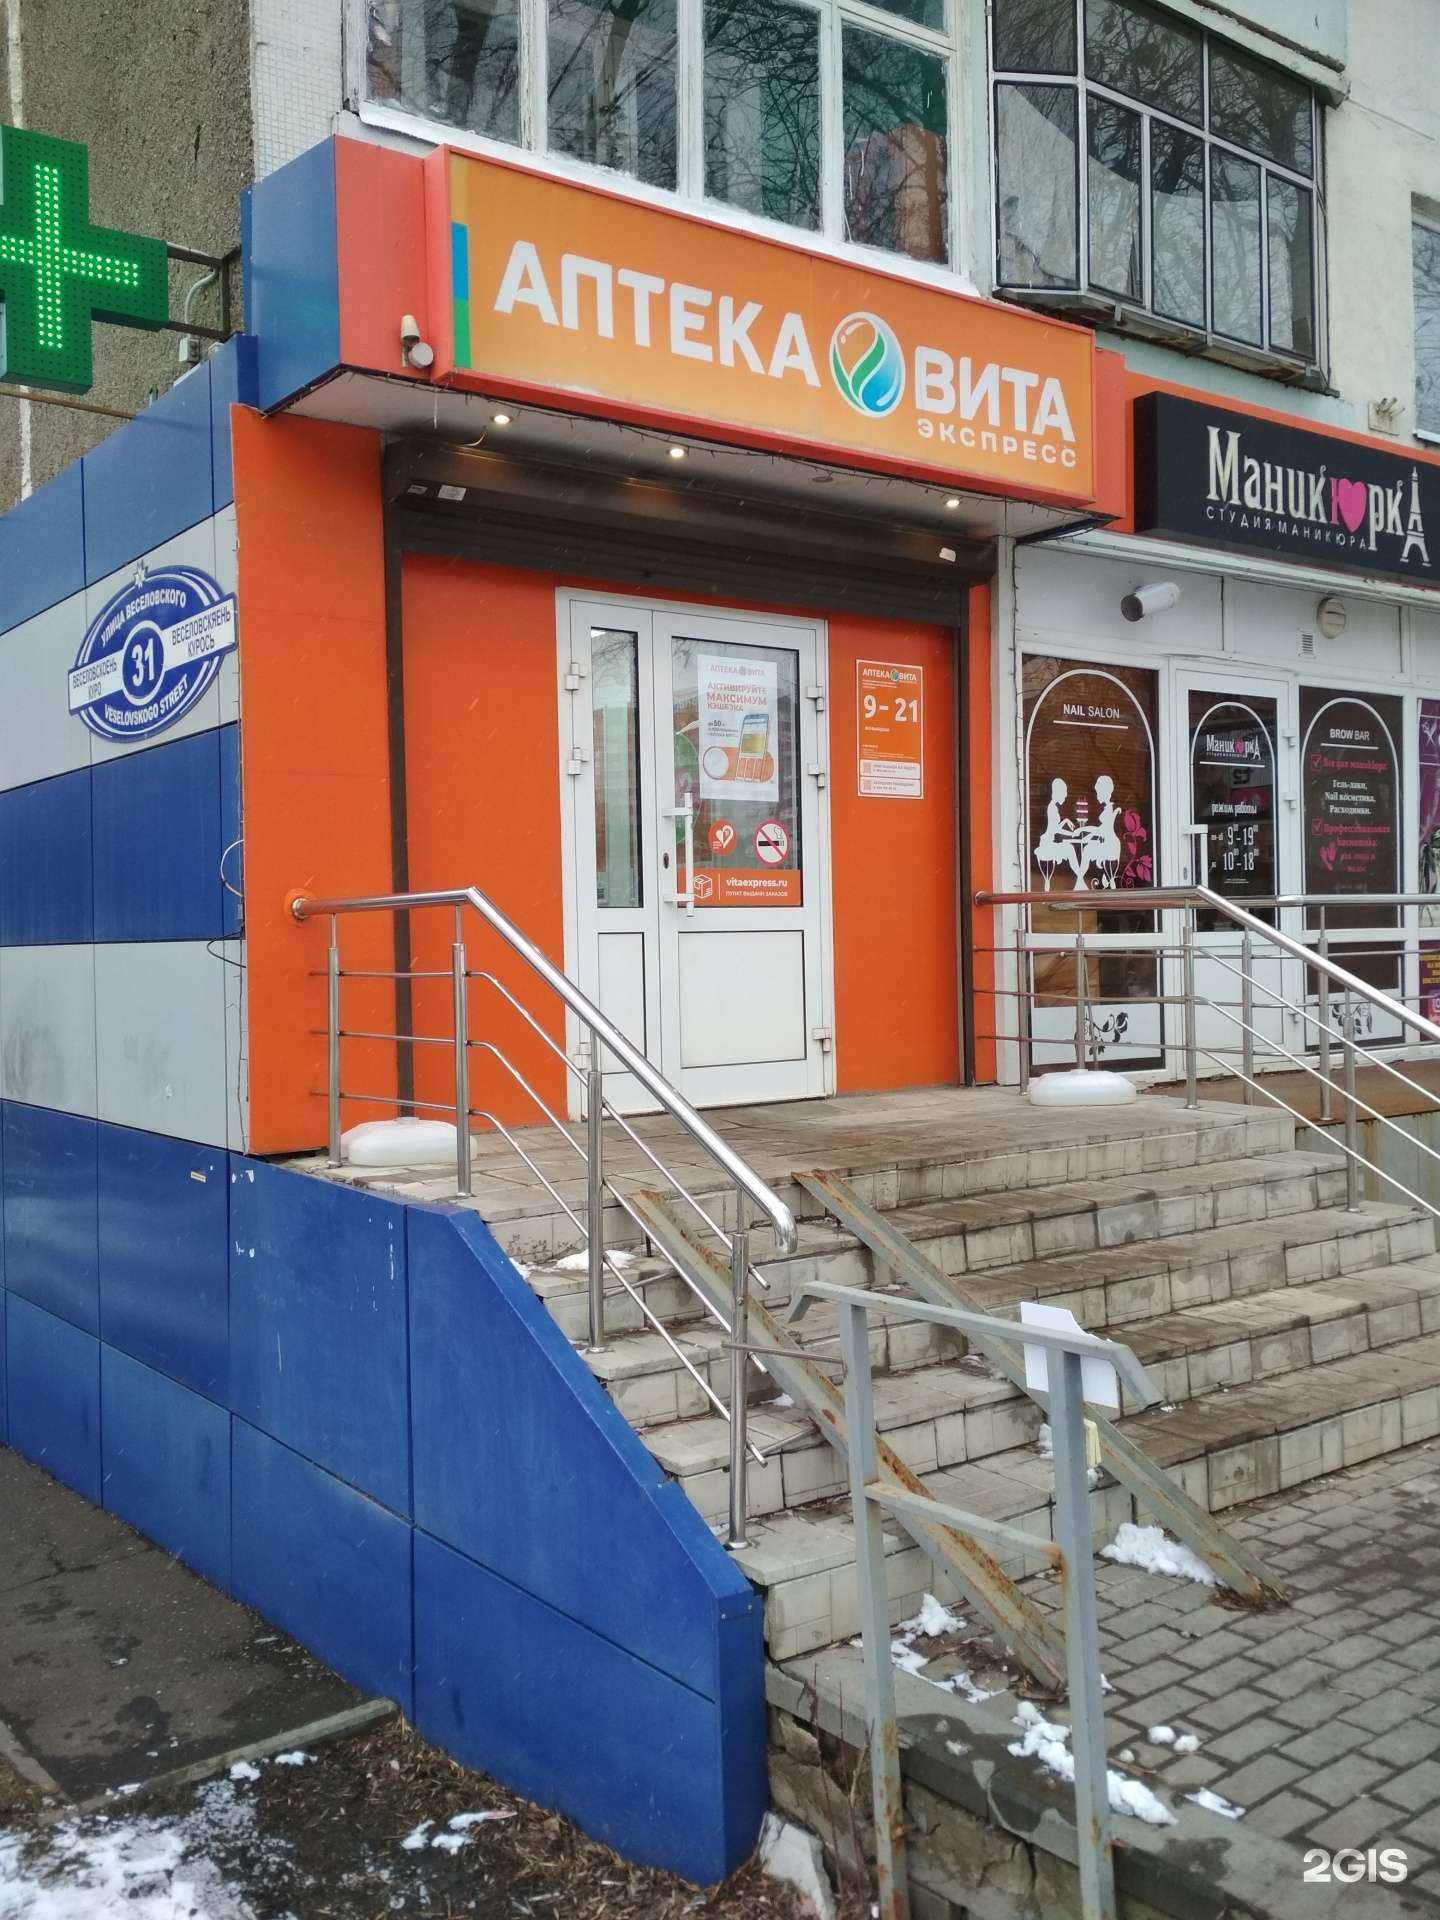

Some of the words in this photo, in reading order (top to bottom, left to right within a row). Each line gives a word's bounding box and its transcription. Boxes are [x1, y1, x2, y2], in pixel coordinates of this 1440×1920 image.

[494, 240, 821, 388] АПТЕКА
[914, 345, 1077, 442] ВИТА
[917, 417, 1077, 469] ЭКСПРЕСС
[1206, 505, 1272, 531] СТУДИЯ
[1278, 521, 1366, 550] МАНИКЮРА
[101, 610, 126, 648] УЛИЦА
[125, 588, 187, 619] ВЕСЕЛОВСКОГО
[132, 638, 155, 687] 31
[187, 636, 216, 657] КУРОСЬ
[862, 668, 891, 680] АПТЕКА
[898, 671, 917, 681] ВИТА
[104, 703, 159, 727] VESELOVSKOGO
[160, 673, 189, 713] STREET
[706, 691, 768, 706] МАКСИМУМ
[1063, 703, 1085, 717] NAIL
[1088, 706, 1120, 719] SALON
[1329, 728, 1353, 740] BROW
[1354, 730, 1370, 741] BAR
[726, 876, 788, 889] vitaexpress.ru
